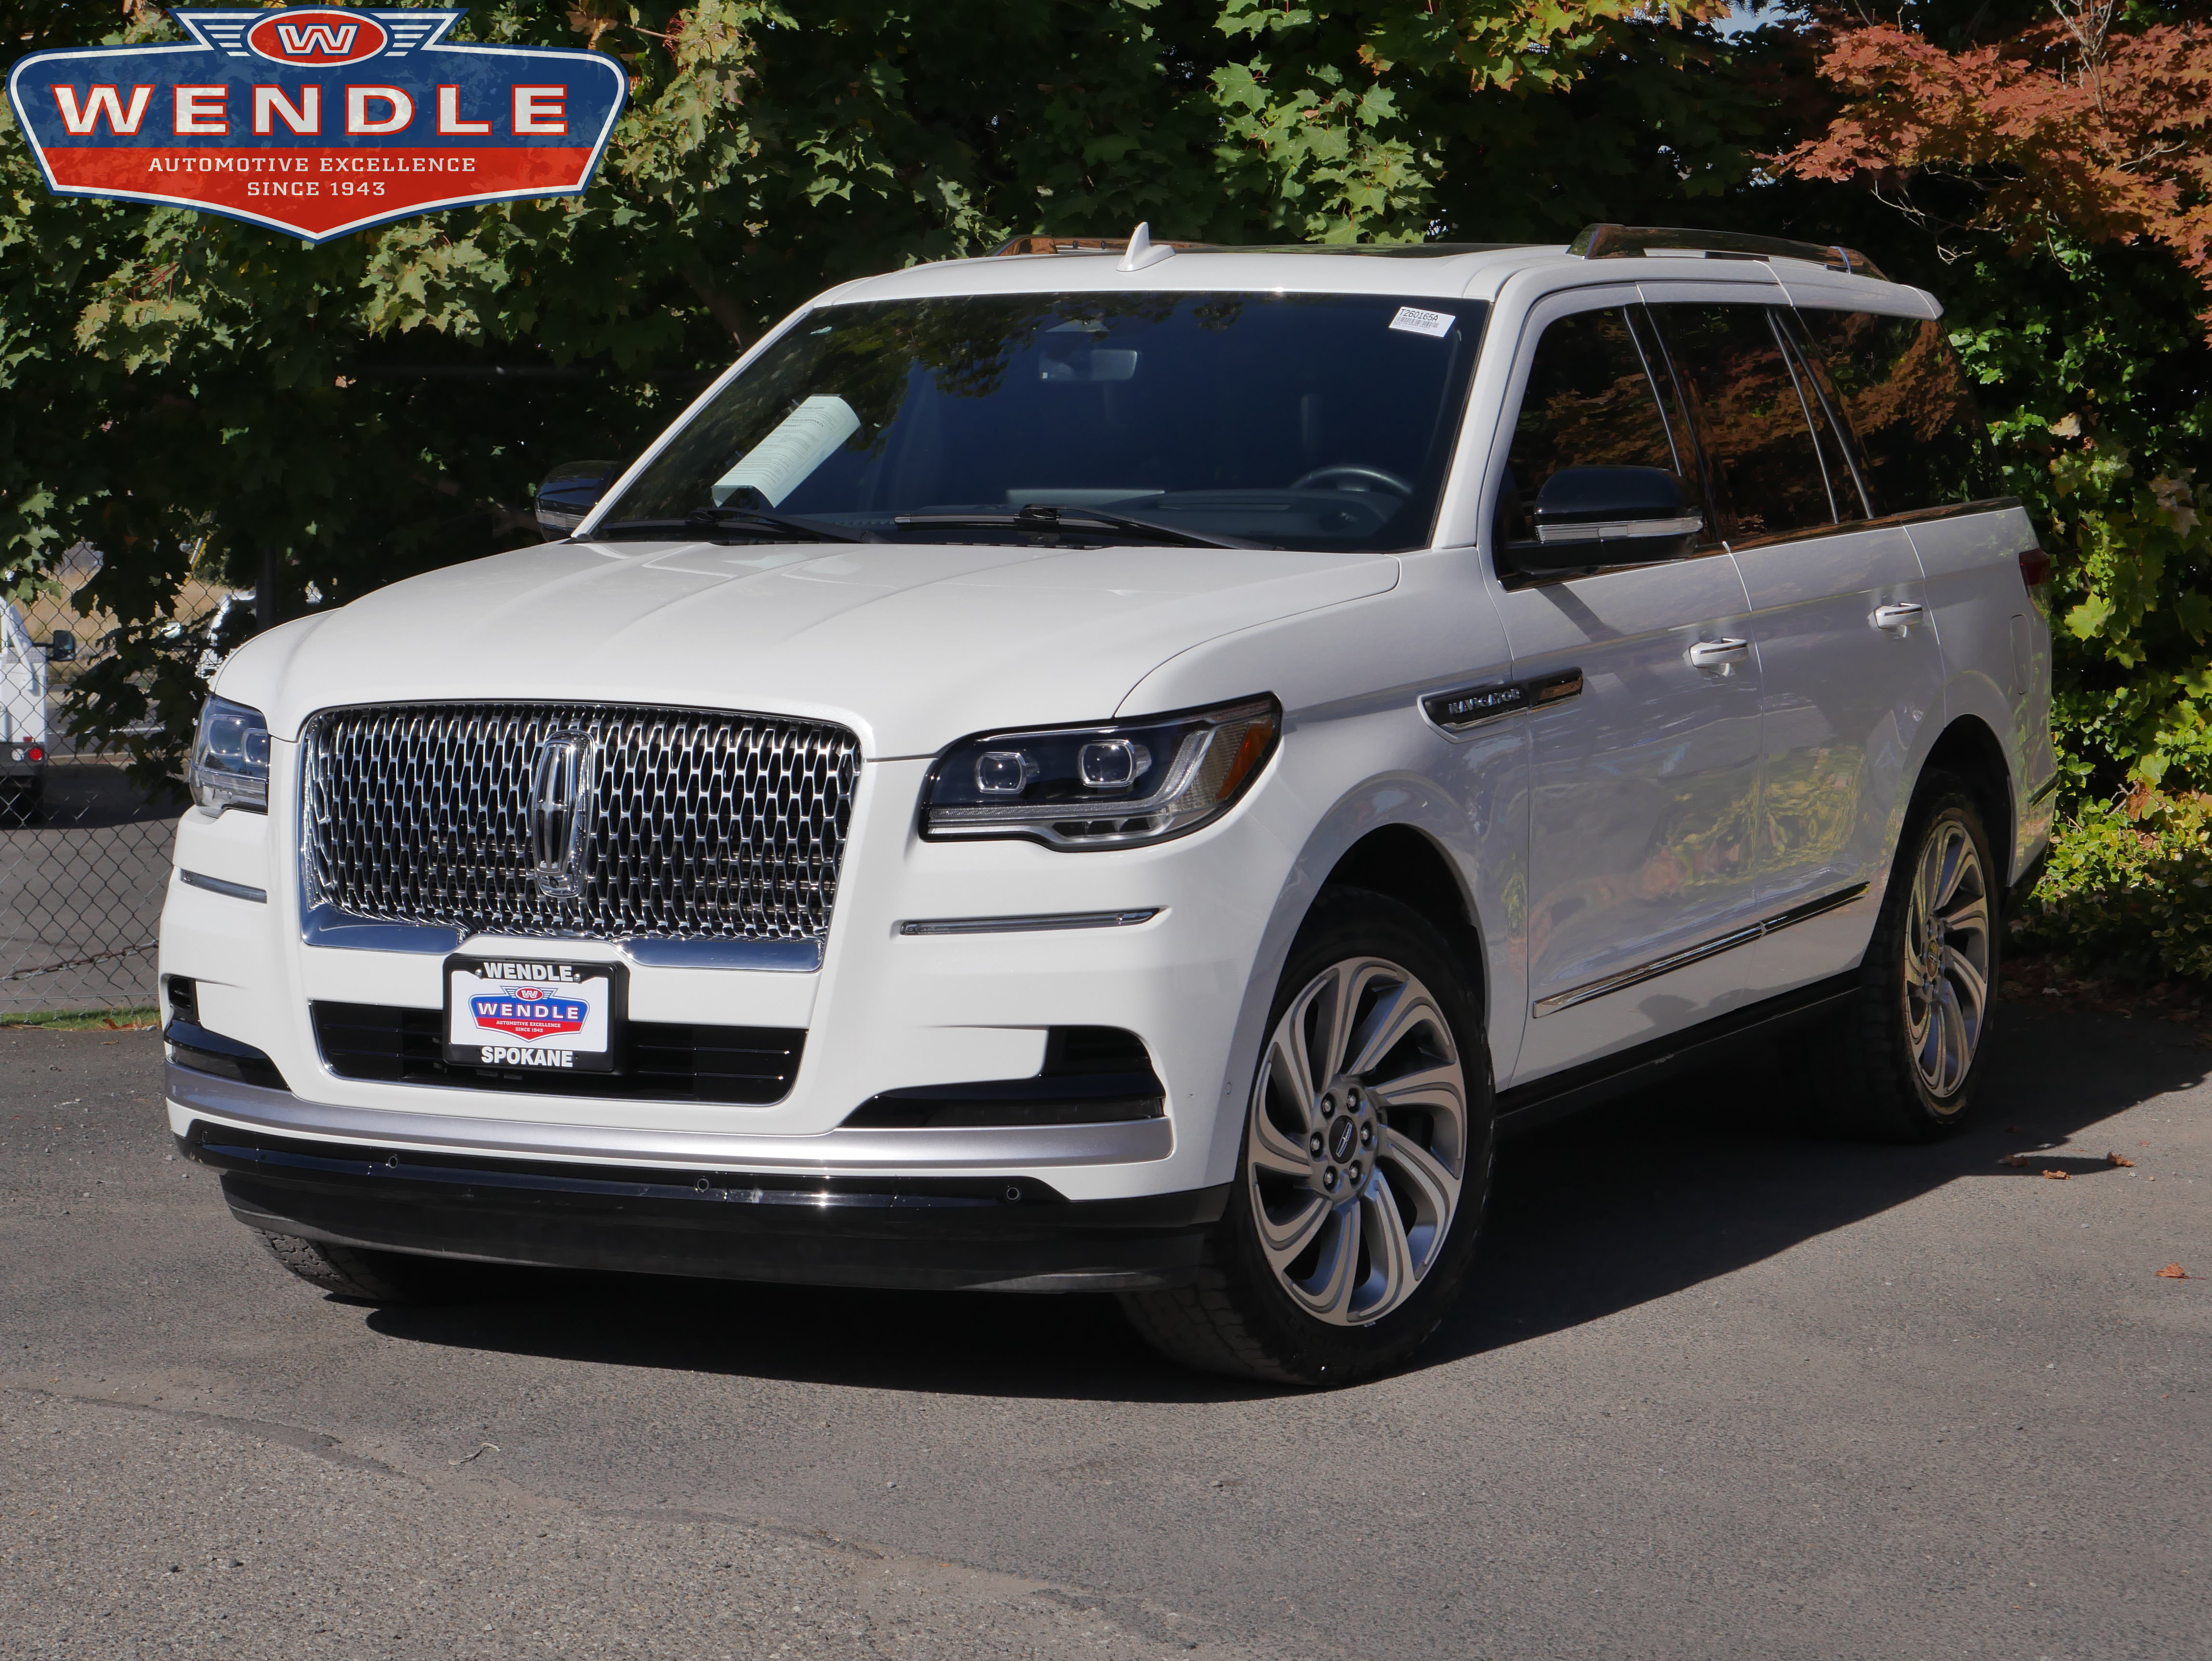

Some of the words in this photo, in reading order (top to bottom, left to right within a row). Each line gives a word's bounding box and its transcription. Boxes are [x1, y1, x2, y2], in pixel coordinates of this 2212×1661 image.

[1399, 309, 1439, 322] T260165A
[483, 962, 574, 982] WENDLE
[477, 1002, 579, 1020] WENDLE
[481, 1046, 574, 1068] SPOKANE
